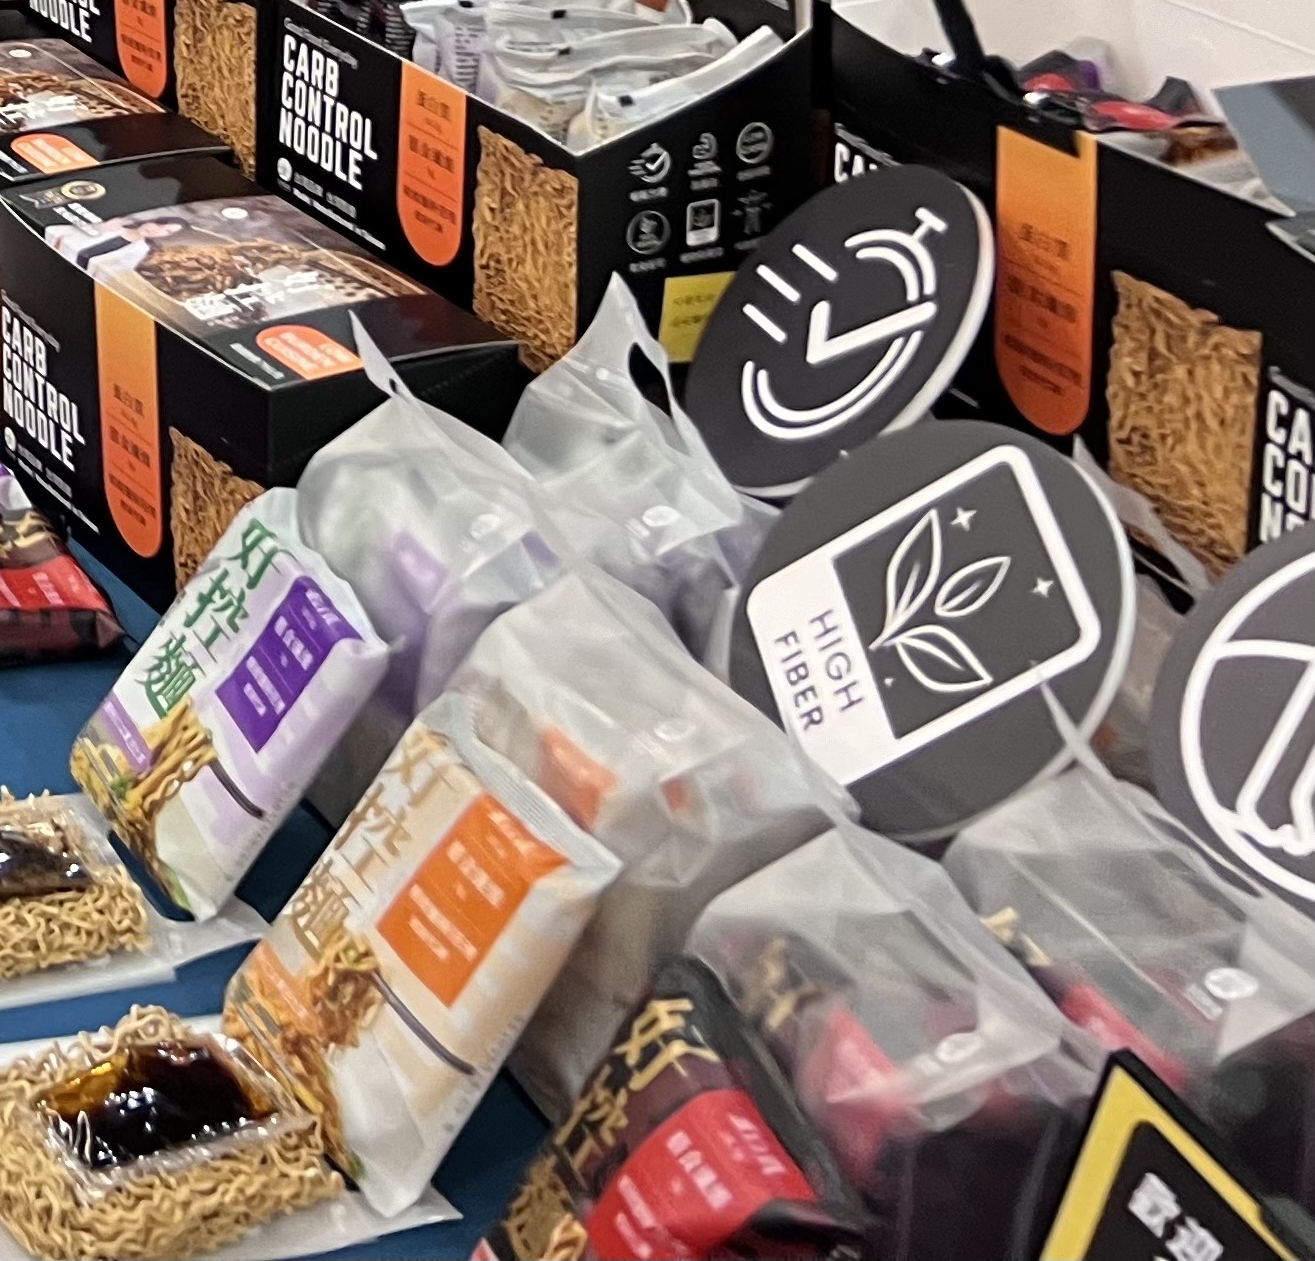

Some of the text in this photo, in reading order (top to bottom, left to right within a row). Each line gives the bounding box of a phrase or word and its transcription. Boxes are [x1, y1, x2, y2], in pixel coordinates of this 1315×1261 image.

[283, 33, 340, 98] CARB
[279, 107, 364, 190] NOODLE
[281, 71, 379, 160] CONTROL
[1, 305, 47, 377] CARB
[2, 342, 86, 446] CONTROL
[2, 377, 76, 472] NOODLE
[1262, 442, 1315, 521] CO
[133, 518, 283, 721] 好控麵
[809, 608, 865, 713] HIGH
[774, 630, 824, 731] FIBER
